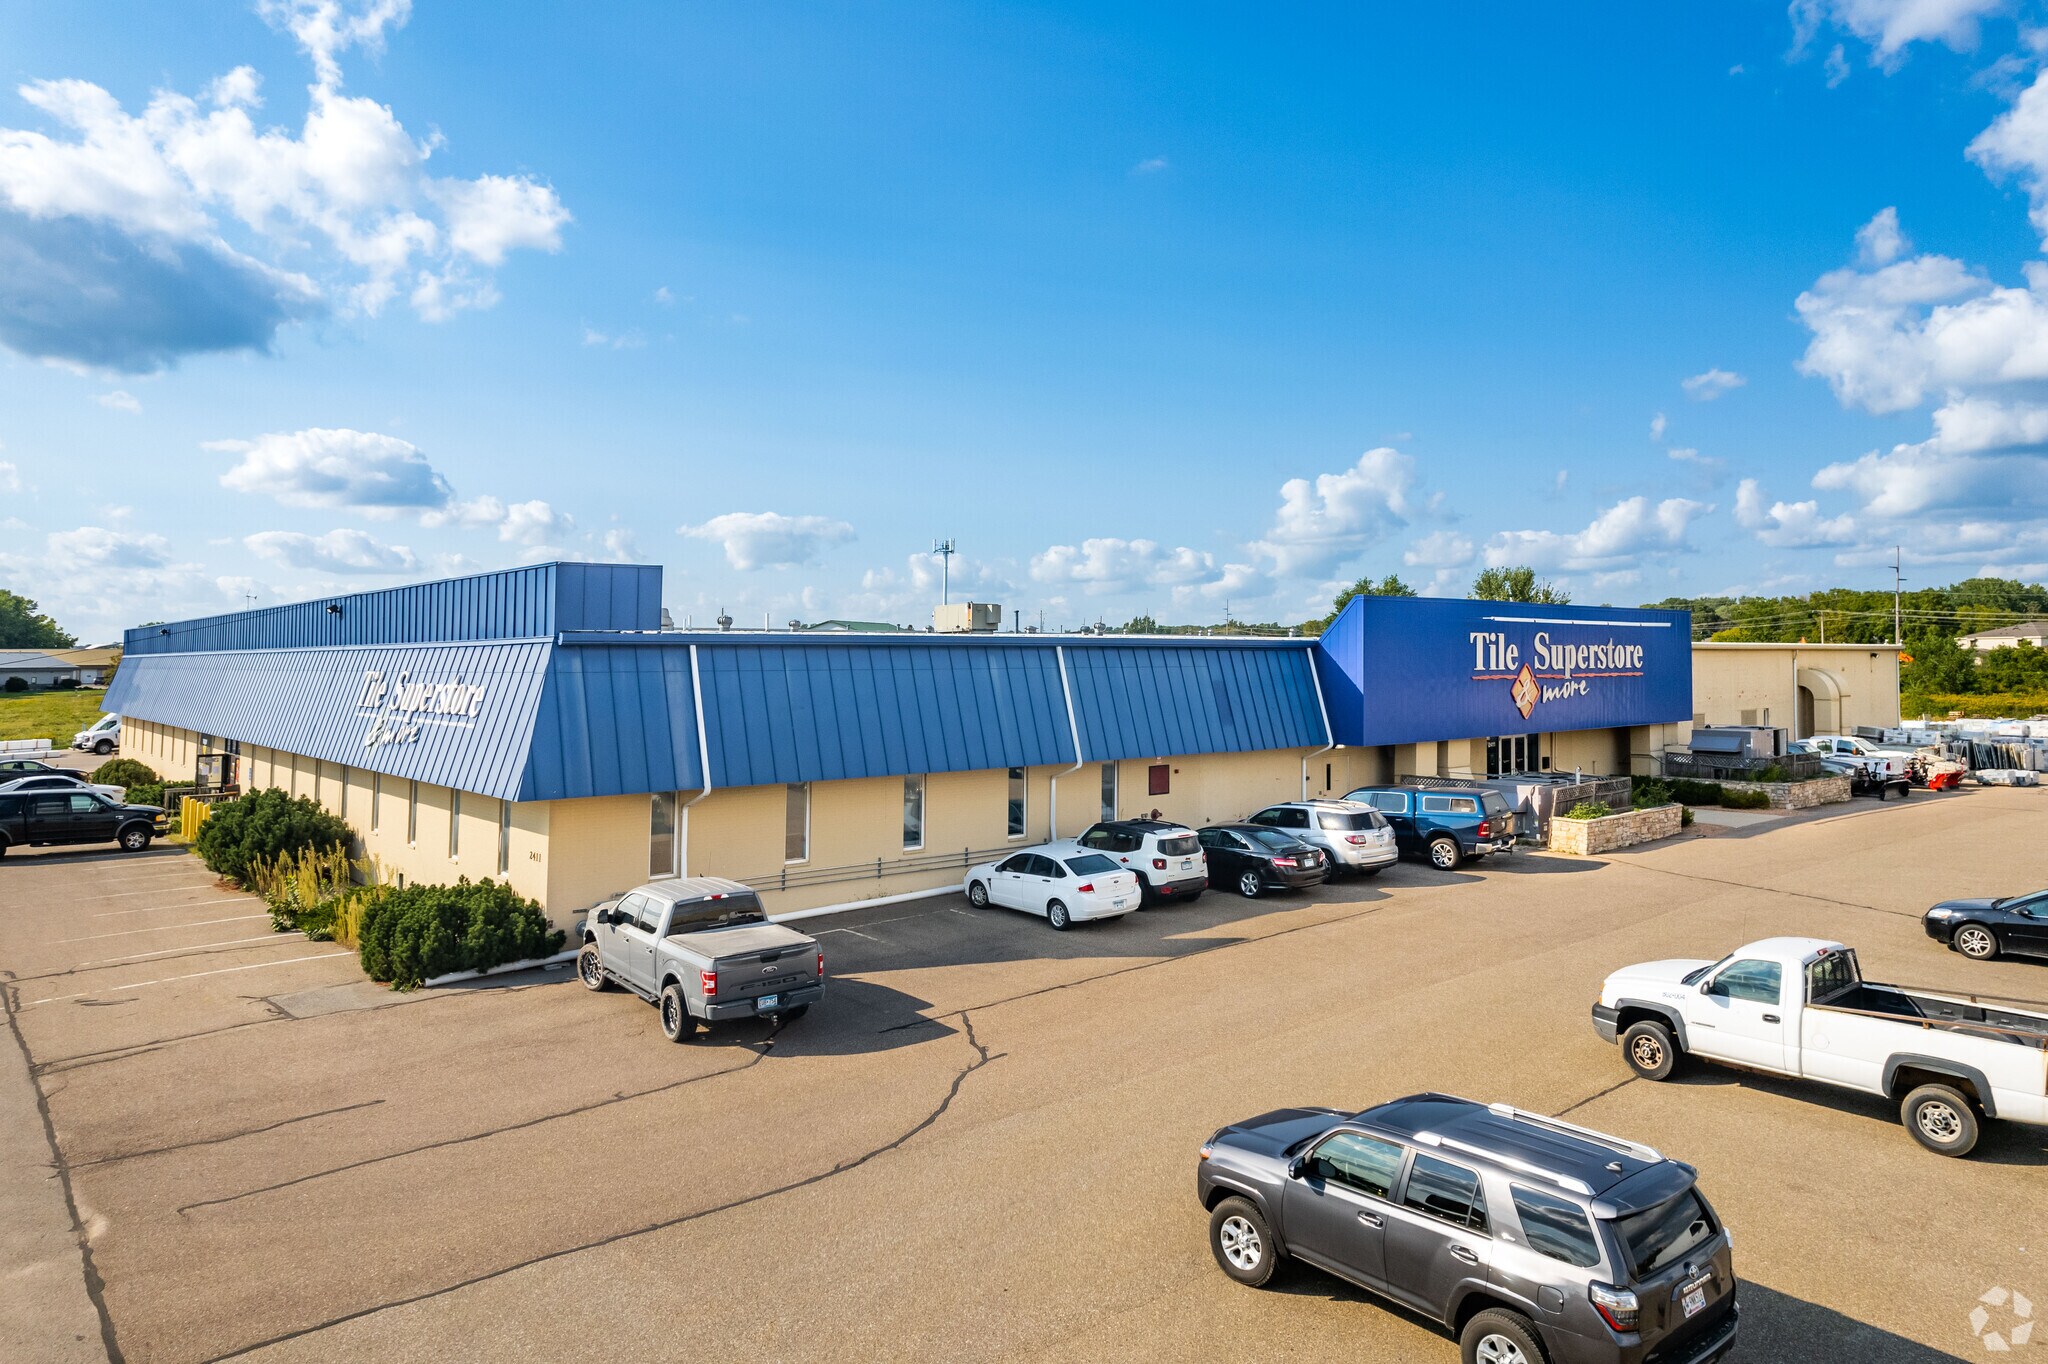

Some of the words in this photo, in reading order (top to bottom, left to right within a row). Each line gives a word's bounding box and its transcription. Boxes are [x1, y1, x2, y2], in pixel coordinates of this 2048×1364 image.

[1470, 632, 1519, 671] Tile
[1534, 632, 1644, 679] Superstore
[357, 670, 388, 708] Tile
[389, 670, 487, 724] Superstore
[1542, 679, 1590, 704] more
[382, 724, 421, 745] more
[530, 851, 542, 862] 2411
